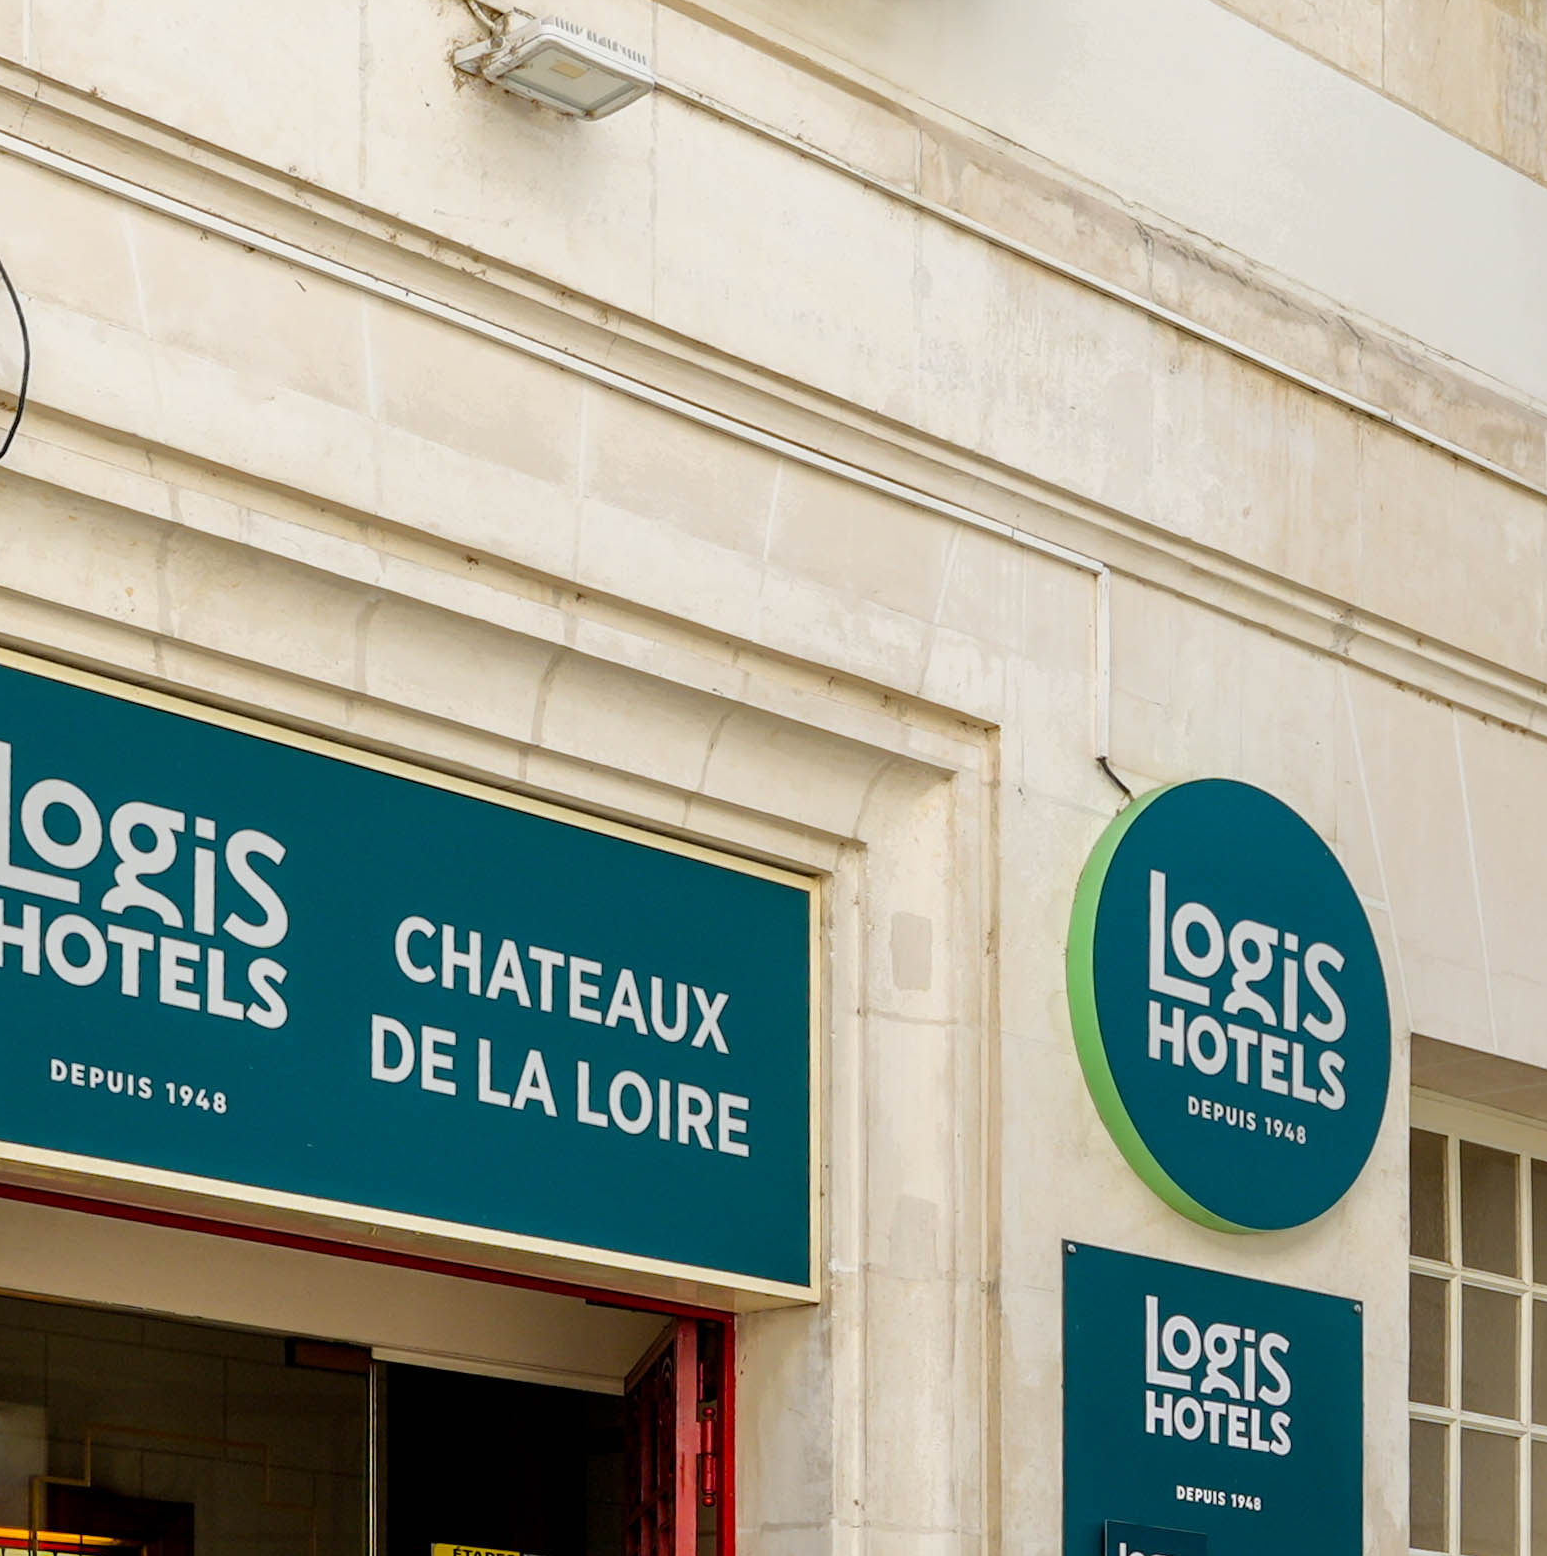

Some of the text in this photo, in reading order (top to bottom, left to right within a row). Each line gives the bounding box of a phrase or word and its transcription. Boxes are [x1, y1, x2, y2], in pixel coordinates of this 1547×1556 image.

[394, 915, 730, 1055] CHATEAUX
[50, 1058, 228, 1114] DEPUIS 1948
[371, 1013, 750, 1158] DE LA LOIRE
[1148, 1000, 1346, 1111] HOTELS
[1188, 1095, 1307, 1145] DEPUIS 1948
[1145, 1390, 1291, 1456] HOTELS
[1176, 1485, 1262, 1511] DEPUIS 1948
